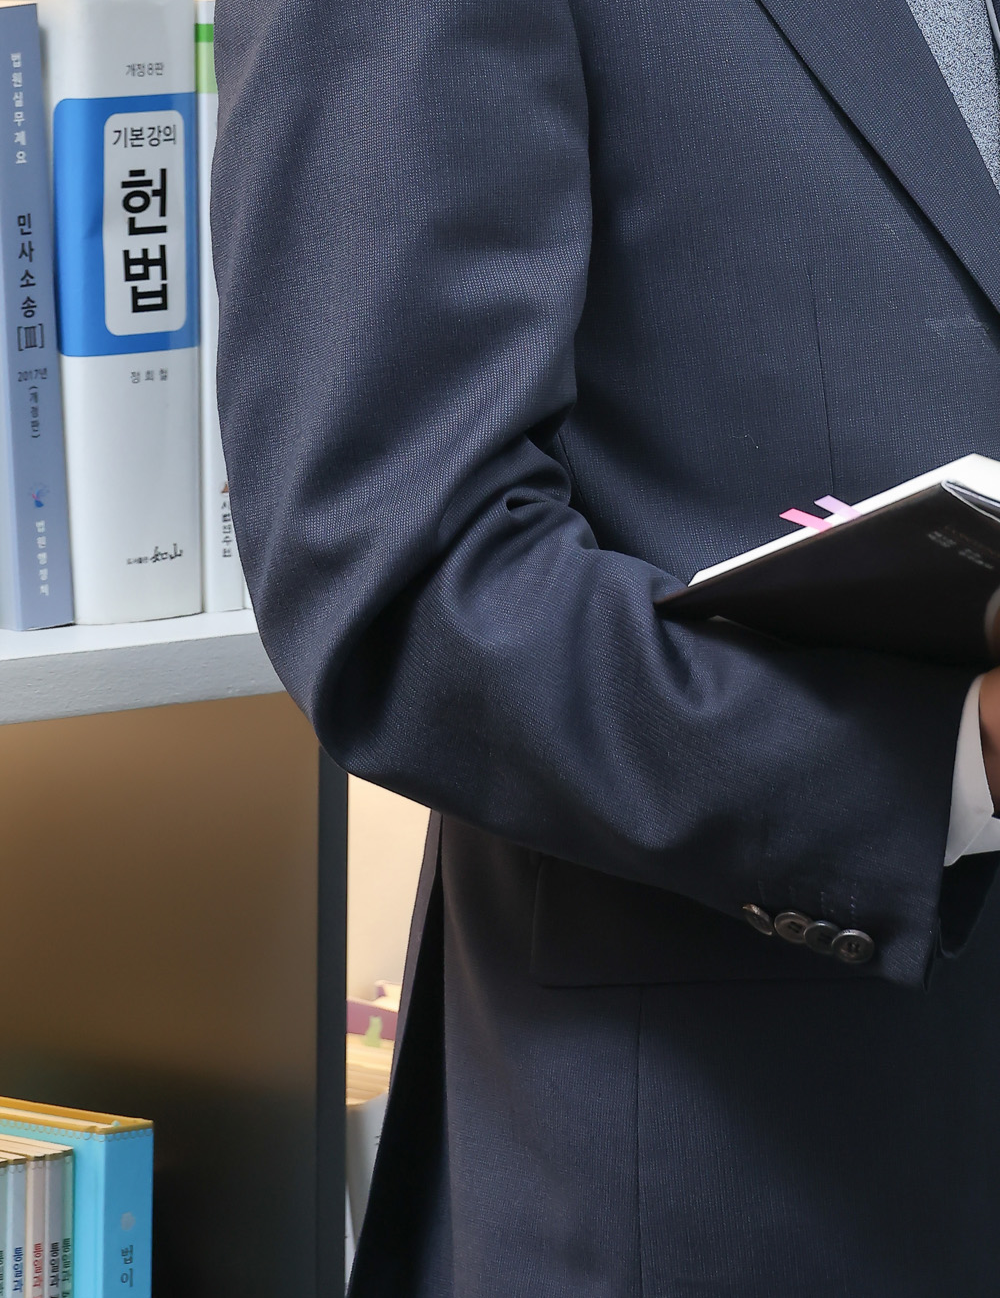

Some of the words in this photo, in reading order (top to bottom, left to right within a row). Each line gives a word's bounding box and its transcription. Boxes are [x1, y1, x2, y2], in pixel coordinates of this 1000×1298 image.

[113, 124, 178, 148] 기본강의
[16, 213, 38, 318] 민사소송
[120, 168, 169, 313] 헌법
[17, 368, 48, 383] 2017년
